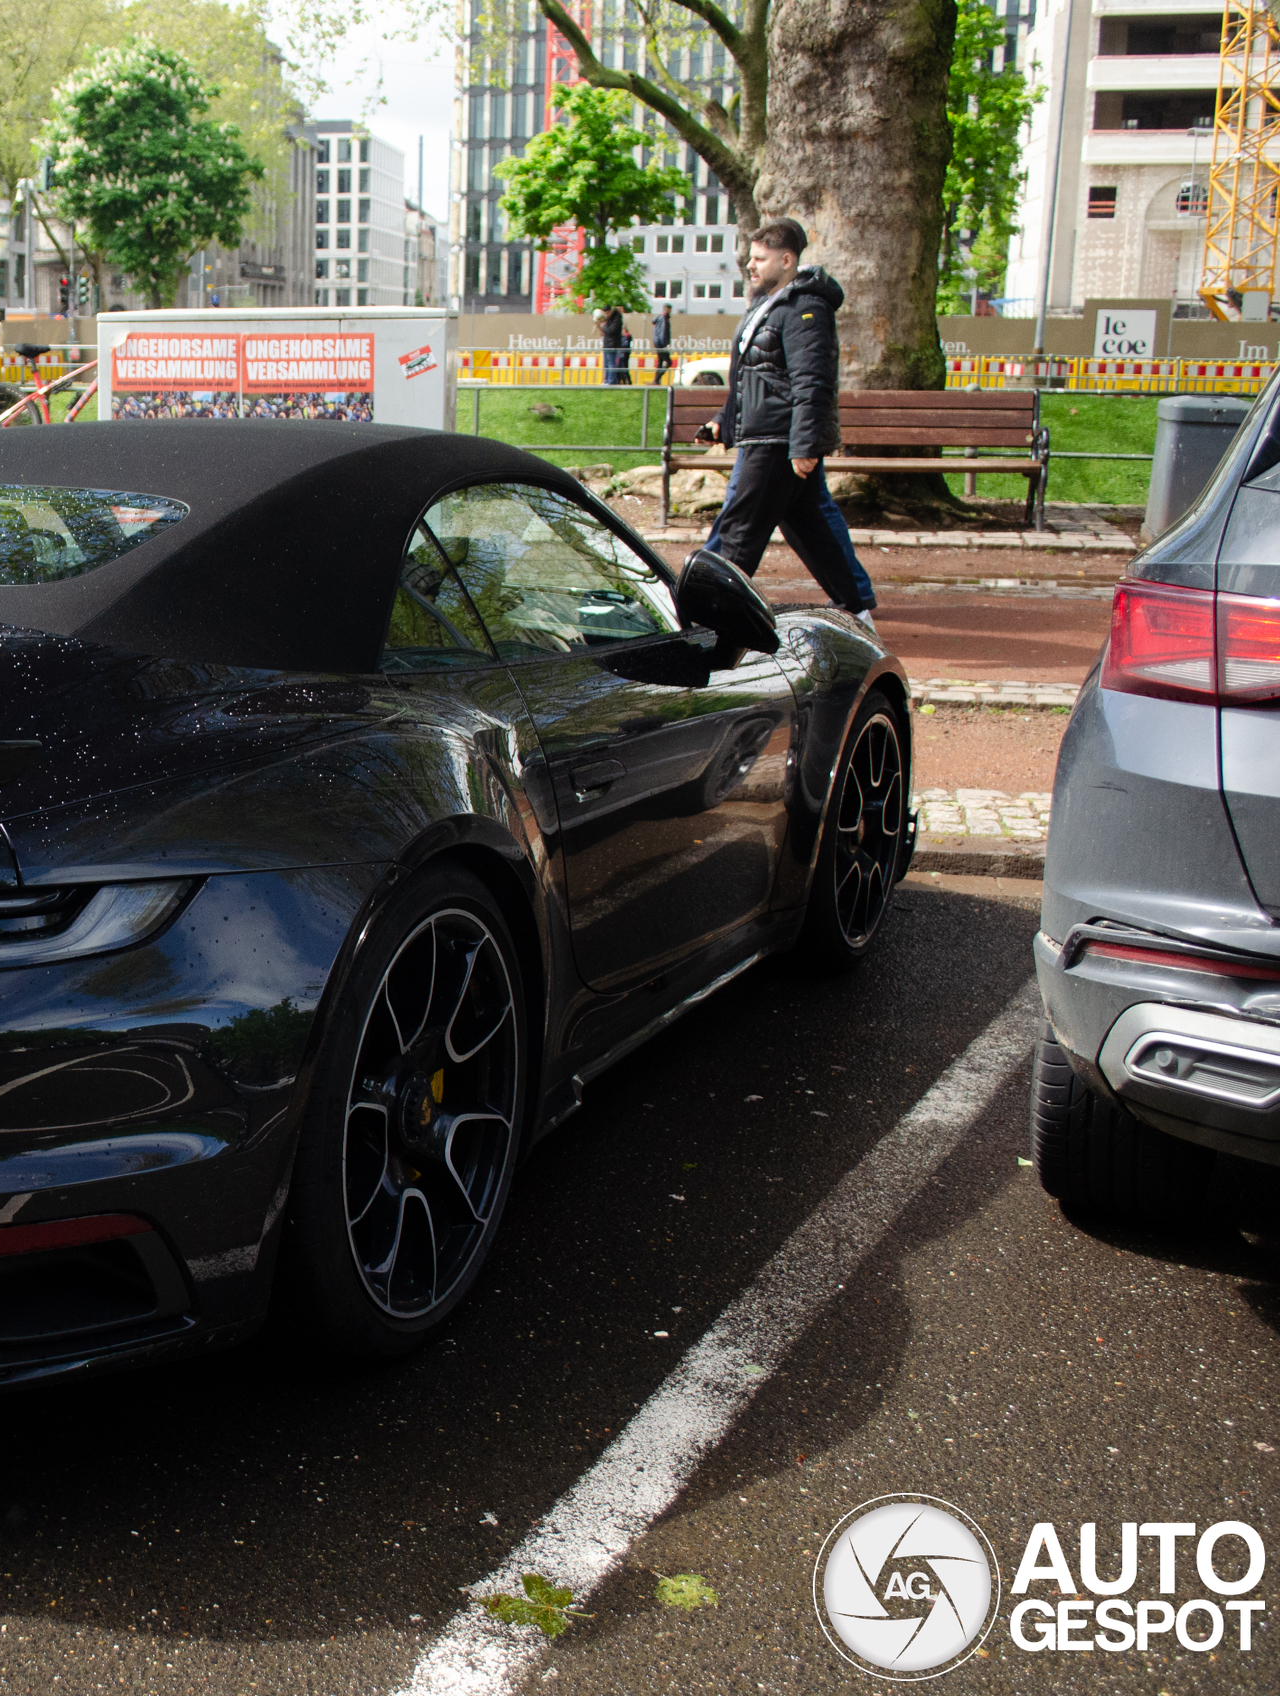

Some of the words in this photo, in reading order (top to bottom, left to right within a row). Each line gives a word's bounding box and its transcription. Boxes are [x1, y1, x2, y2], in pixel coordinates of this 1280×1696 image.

[1102, 316, 1127, 335] le
[245, 338, 371, 359] UNGEHORSAME
[667, 335, 733, 350] röbsten
[1102, 339, 1147, 355] coe
[1237, 339, 1269, 360] Im
[116, 359, 237, 379] VERSAMMLUNG
[246, 360, 371, 380] VERSAMMLUNG
